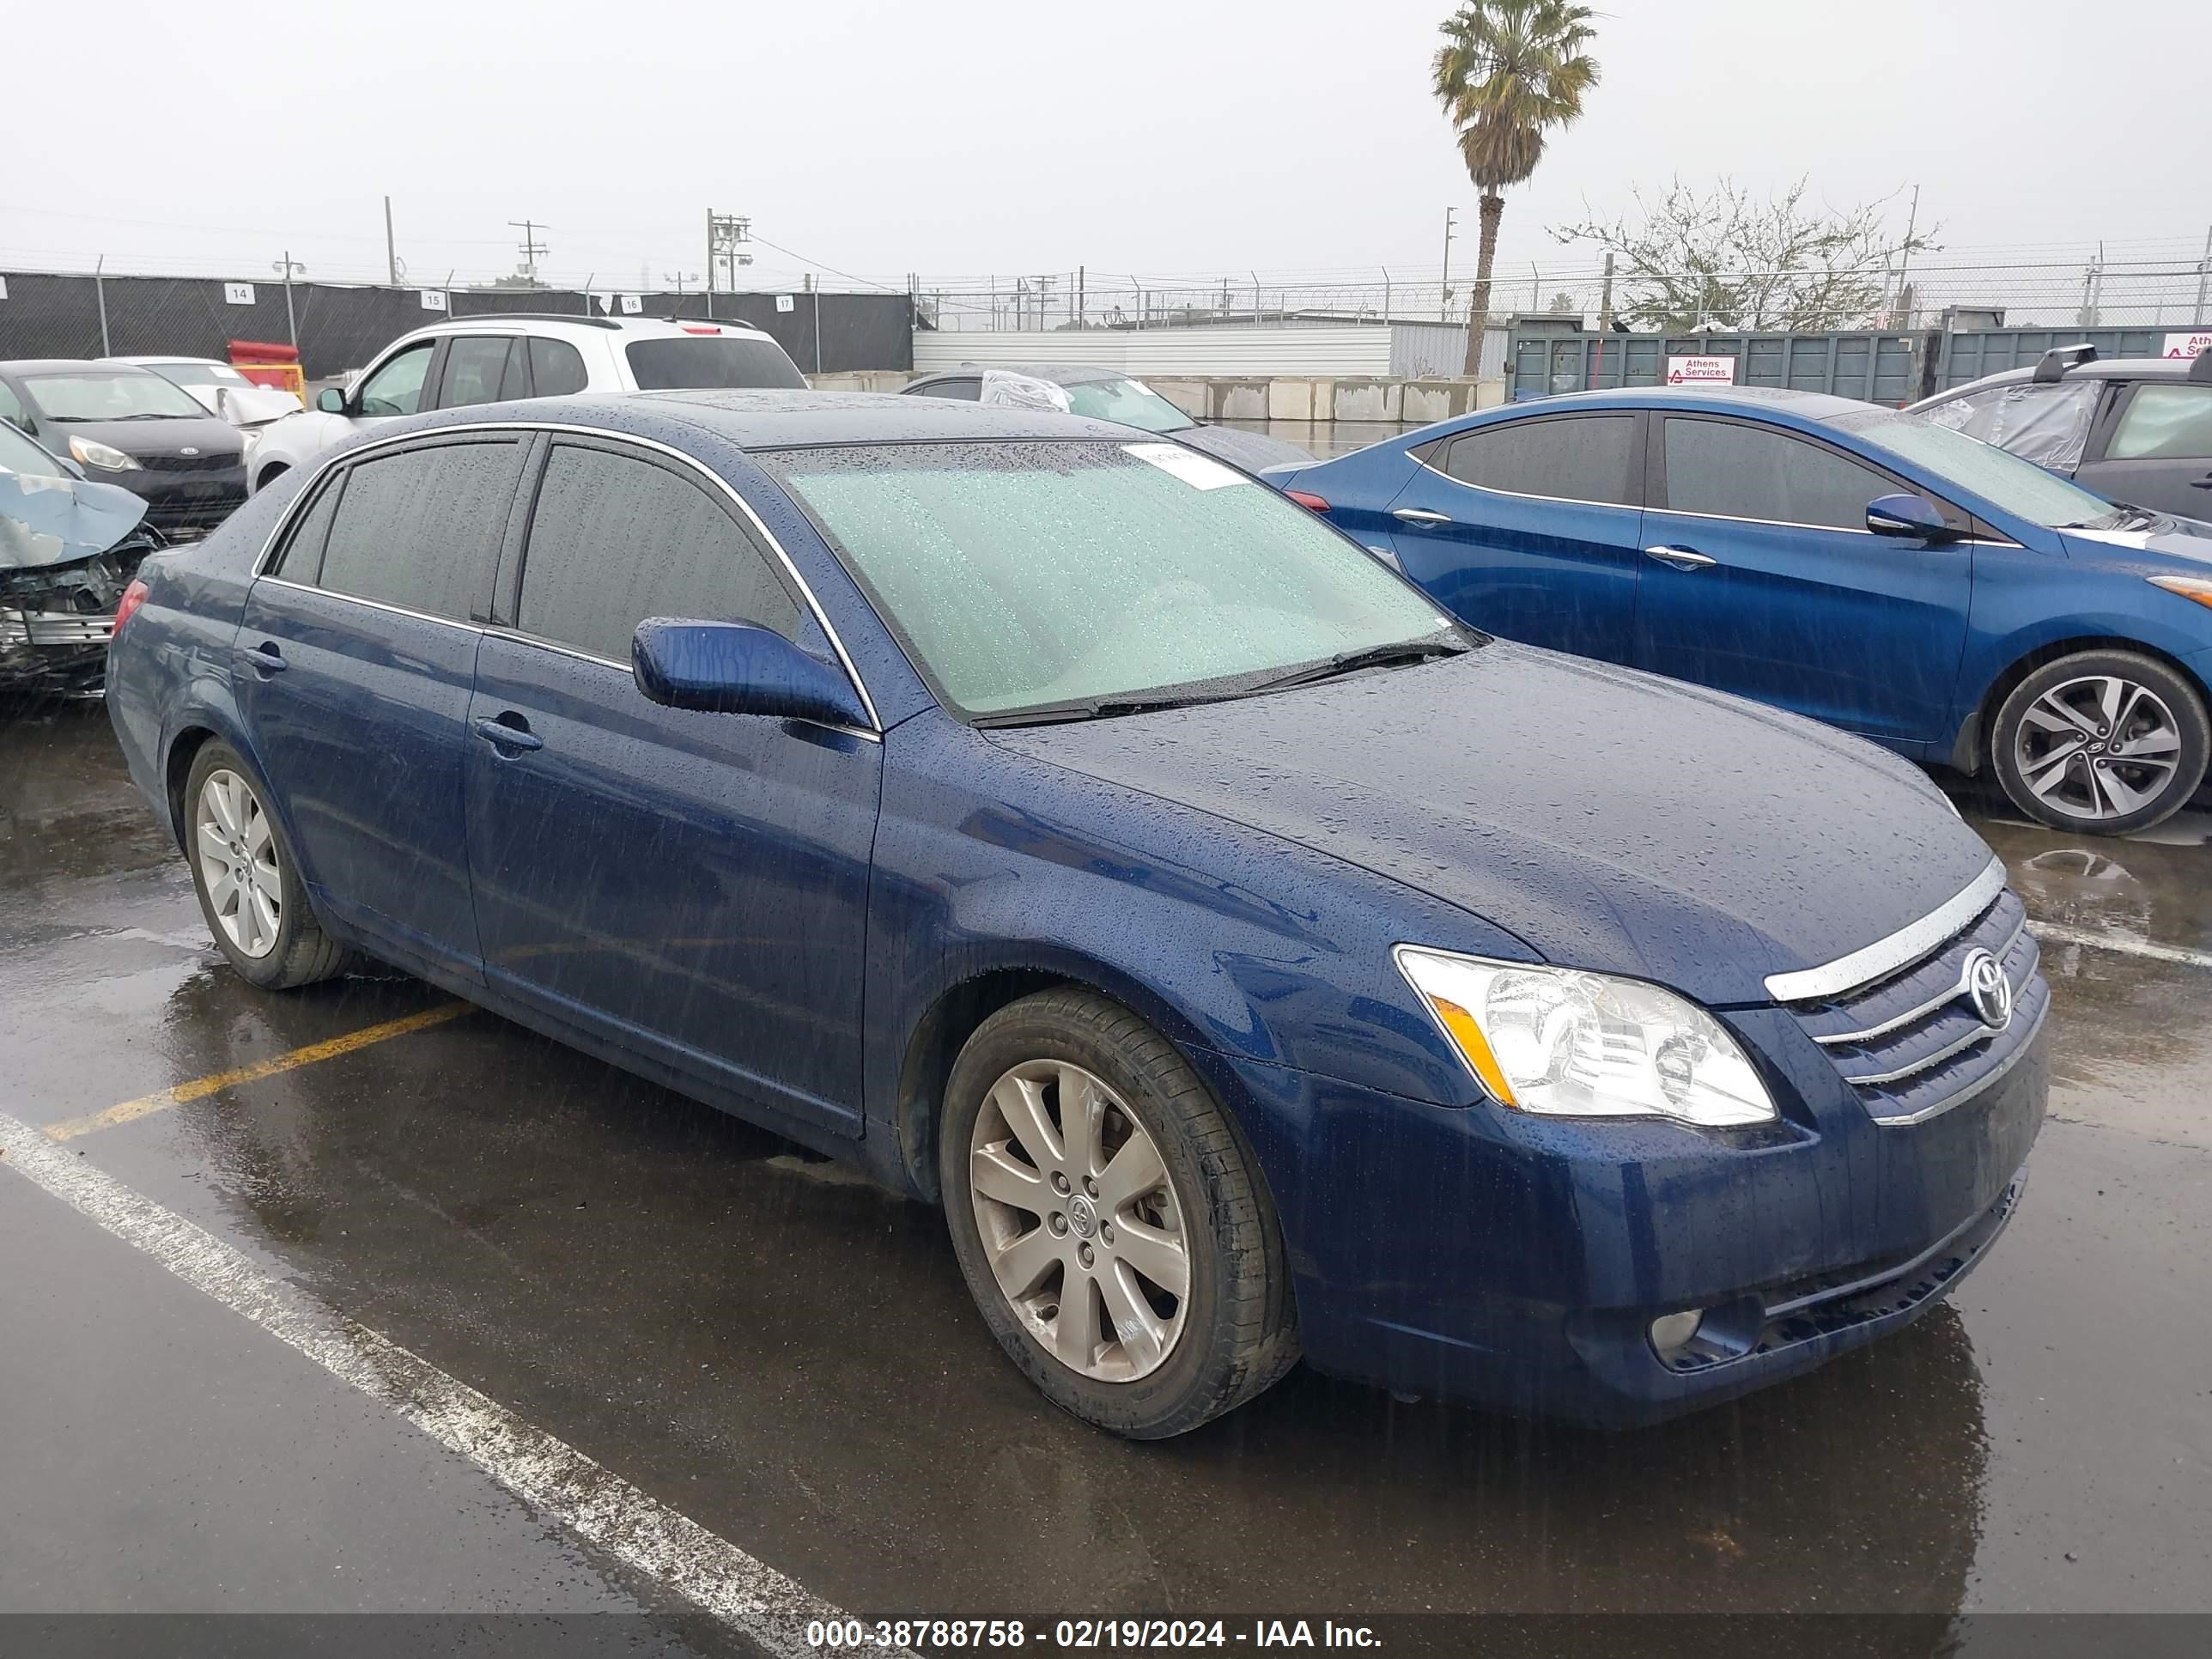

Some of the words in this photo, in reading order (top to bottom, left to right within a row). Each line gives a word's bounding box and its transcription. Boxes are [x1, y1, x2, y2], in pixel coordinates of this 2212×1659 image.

[234, 289, 247, 299] 14
[428, 295, 441, 306] 15
[781, 300, 789, 308] 17
[627, 301, 637, 310] 16
[1686, 359, 1719, 368] Athens
[1685, 368, 1726, 377] Services
